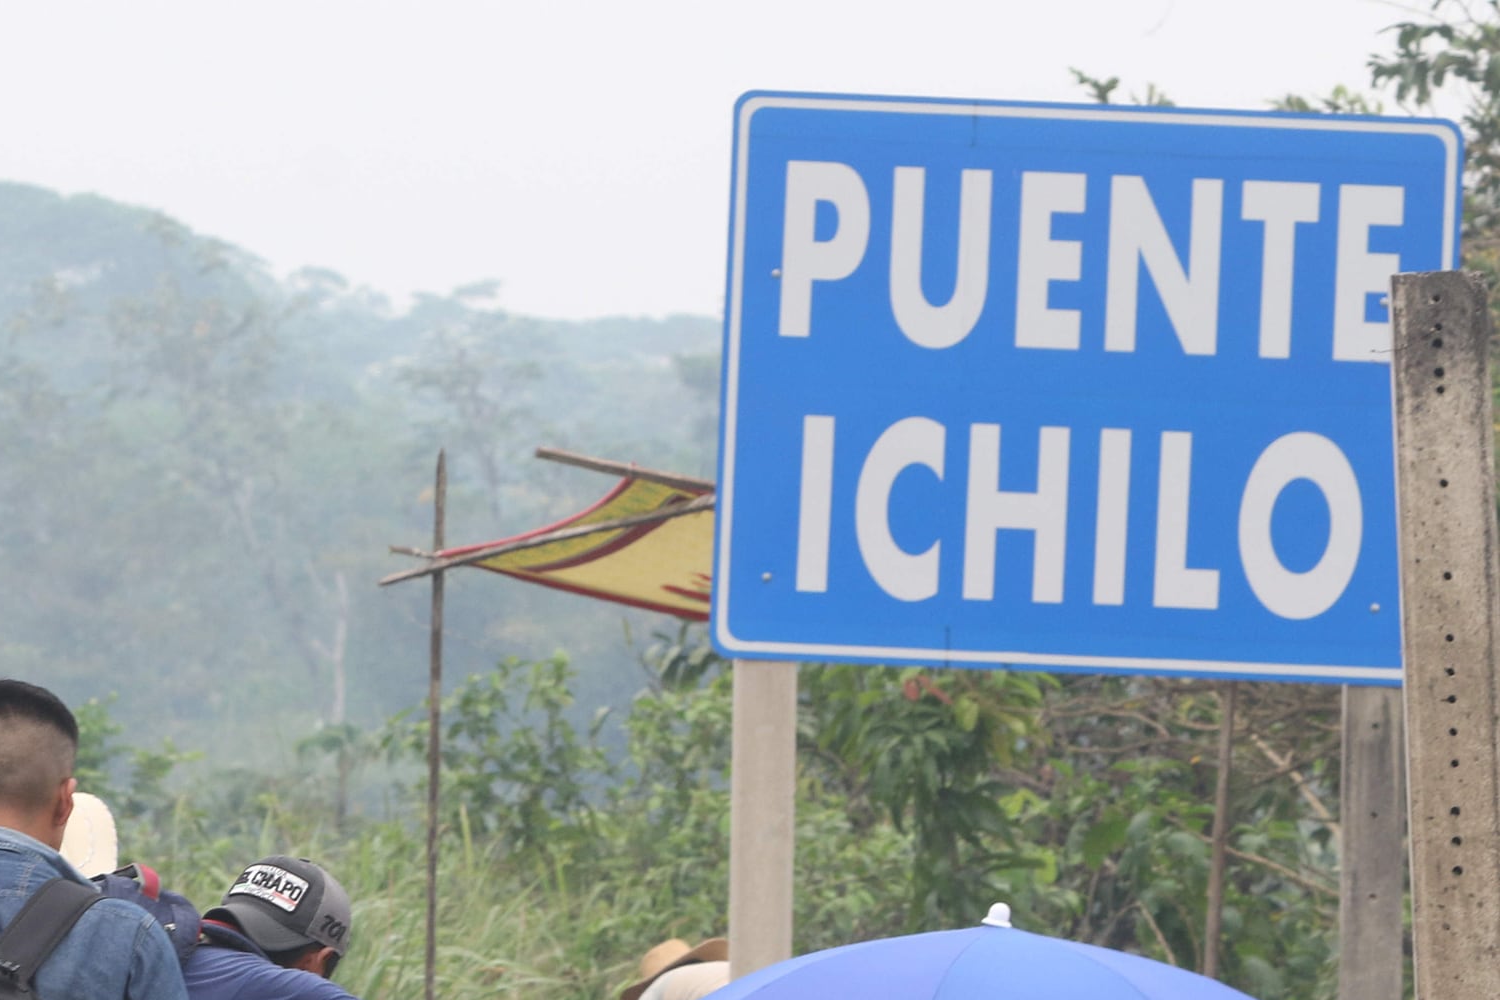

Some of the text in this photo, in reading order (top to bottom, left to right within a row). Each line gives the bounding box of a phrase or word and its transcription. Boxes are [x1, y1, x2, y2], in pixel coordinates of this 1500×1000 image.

[779, 160, 1405, 363] PUENTE
[796, 414, 1363, 621] ICHILO
[251, 870, 303, 902] CHAPO
